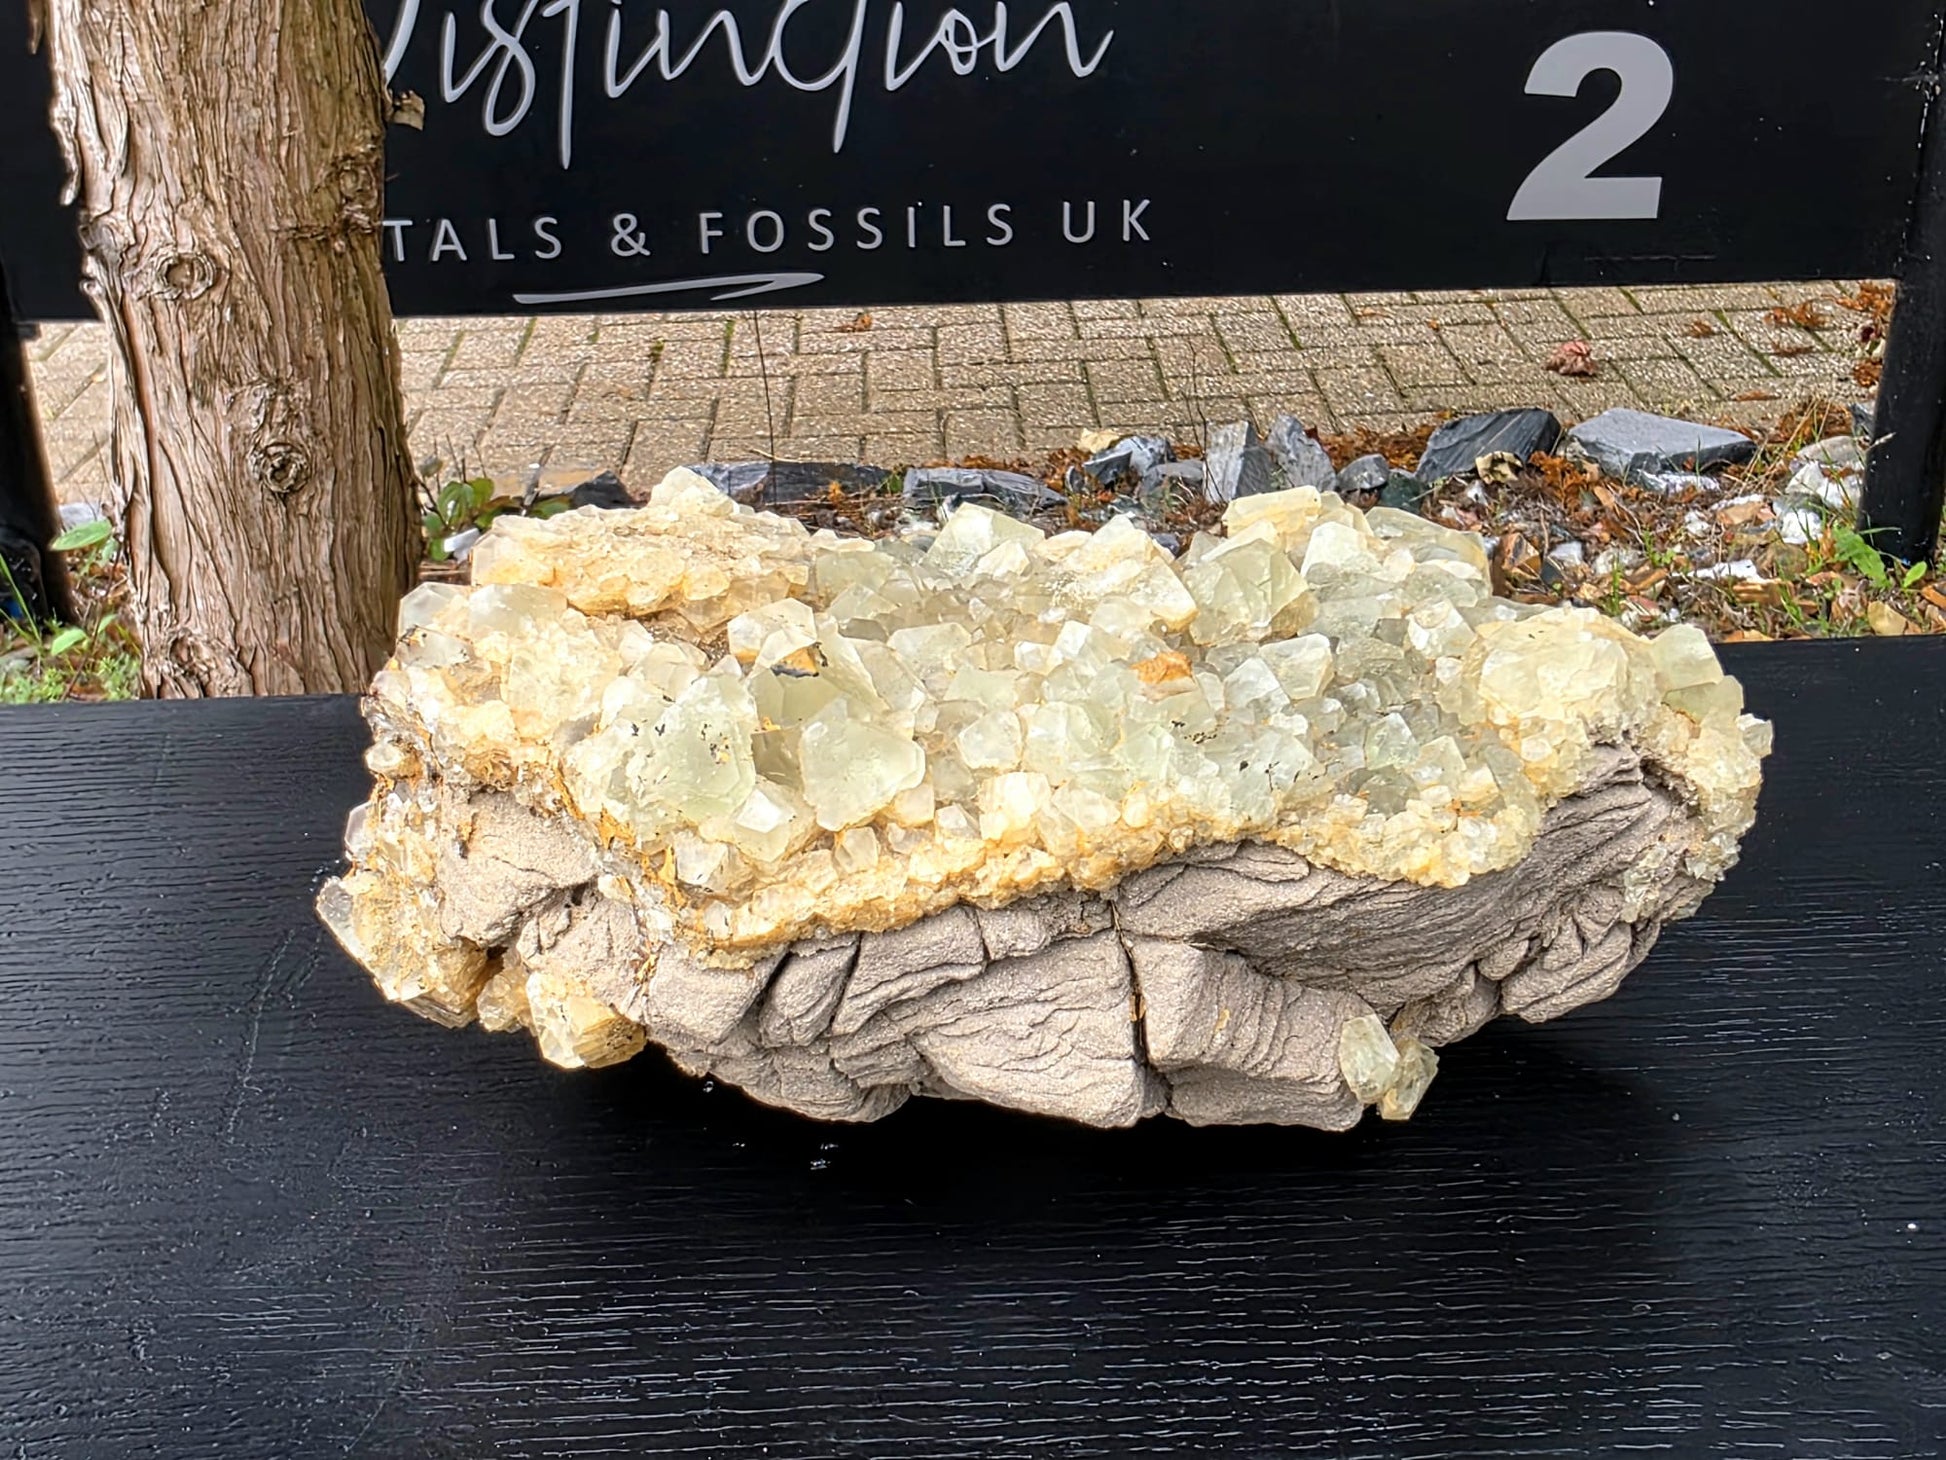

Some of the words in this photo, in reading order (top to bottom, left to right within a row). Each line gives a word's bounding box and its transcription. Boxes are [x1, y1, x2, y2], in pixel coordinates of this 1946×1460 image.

[384, 0, 1114, 169] istinction
[1506, 31, 1673, 221] 2
[610, 213, 651, 257] &
[699, 203, 1013, 255] FOSSILS
[1062, 199, 1151, 243] UK
